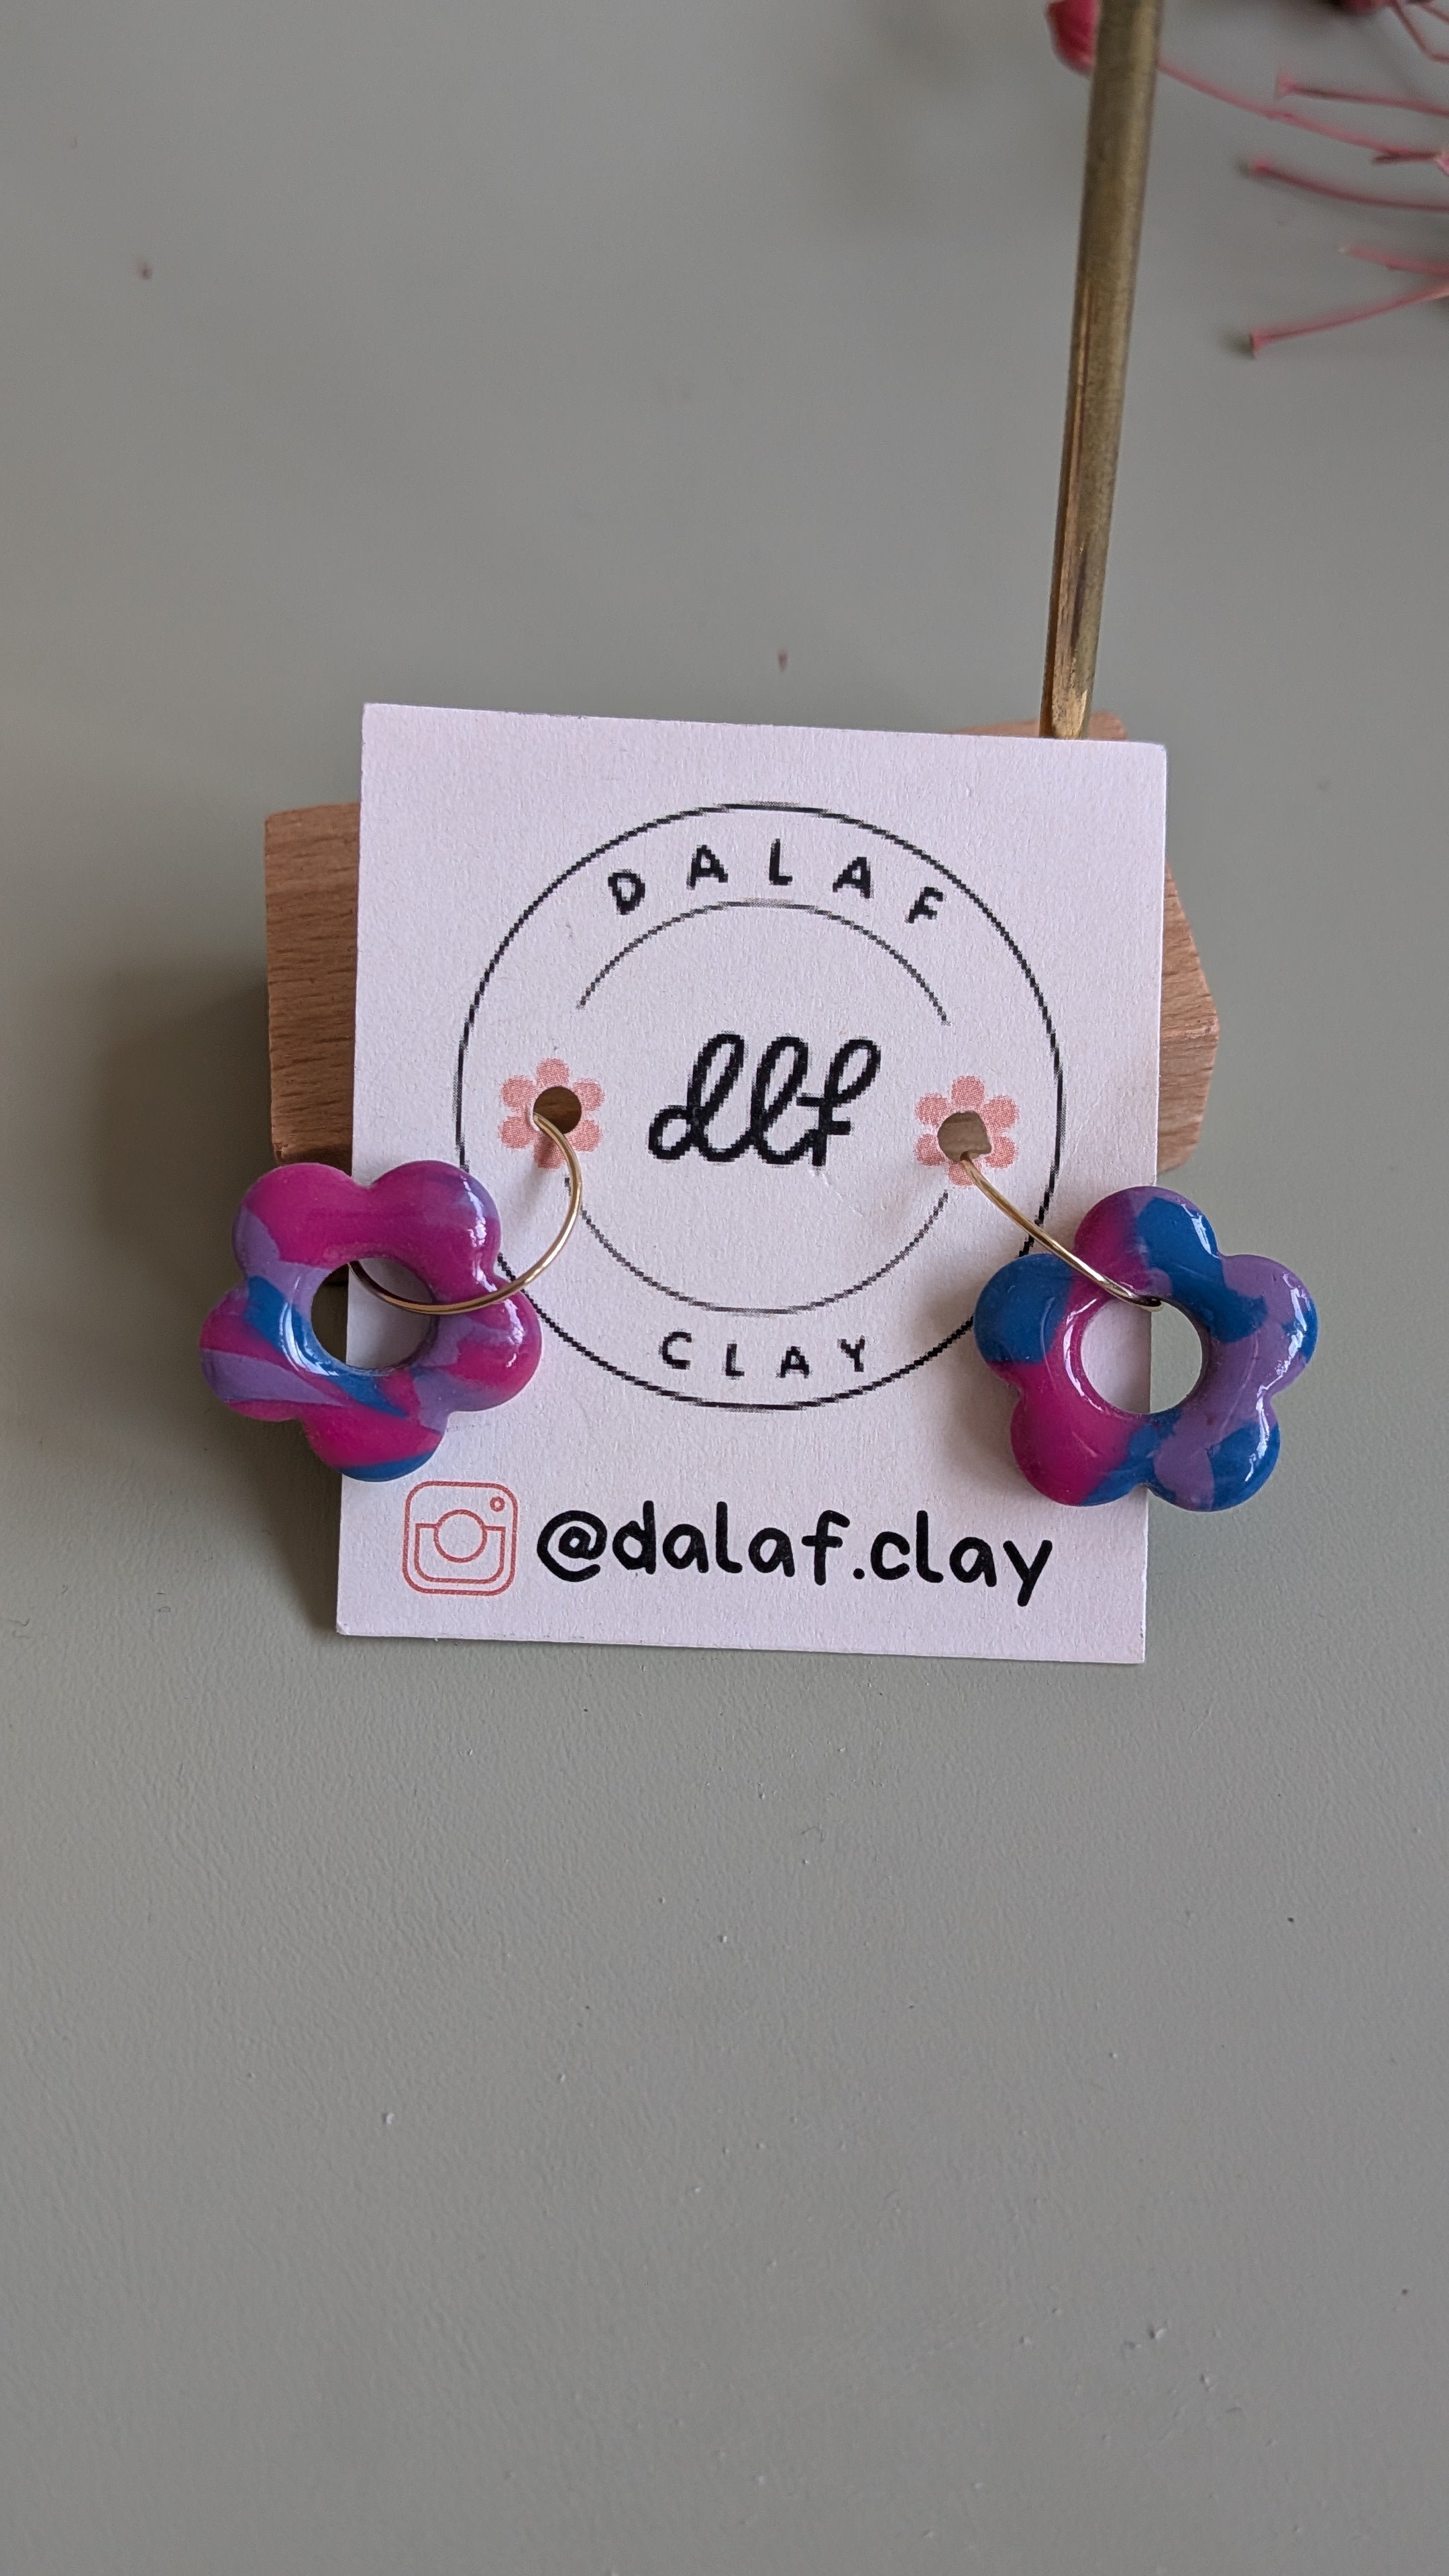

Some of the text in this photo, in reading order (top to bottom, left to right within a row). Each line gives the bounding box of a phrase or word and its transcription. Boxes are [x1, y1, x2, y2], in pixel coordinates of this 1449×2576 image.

[606, 838, 947, 926] DALAF
[657, 1330, 869, 1381] CLAY
[536, 1499, 1053, 1608] @dalaf.clay
